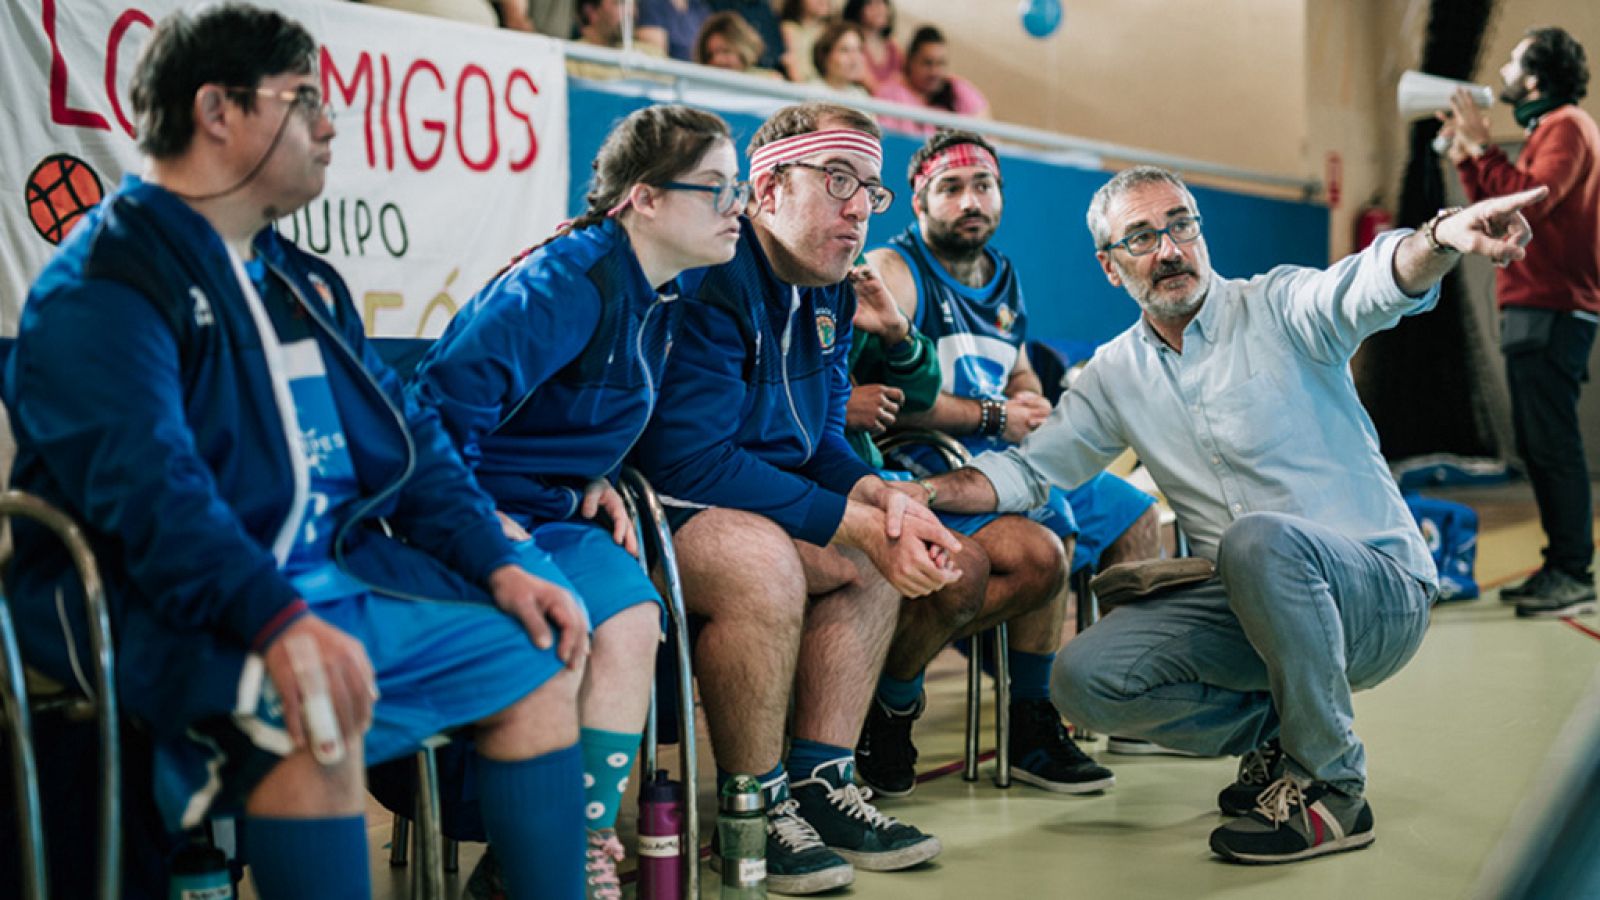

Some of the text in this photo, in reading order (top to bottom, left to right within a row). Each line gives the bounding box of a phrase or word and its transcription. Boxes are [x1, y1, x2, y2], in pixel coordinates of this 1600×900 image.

[41, 0, 540, 173] LO MIGOS
[292, 197, 409, 259] UIPO
